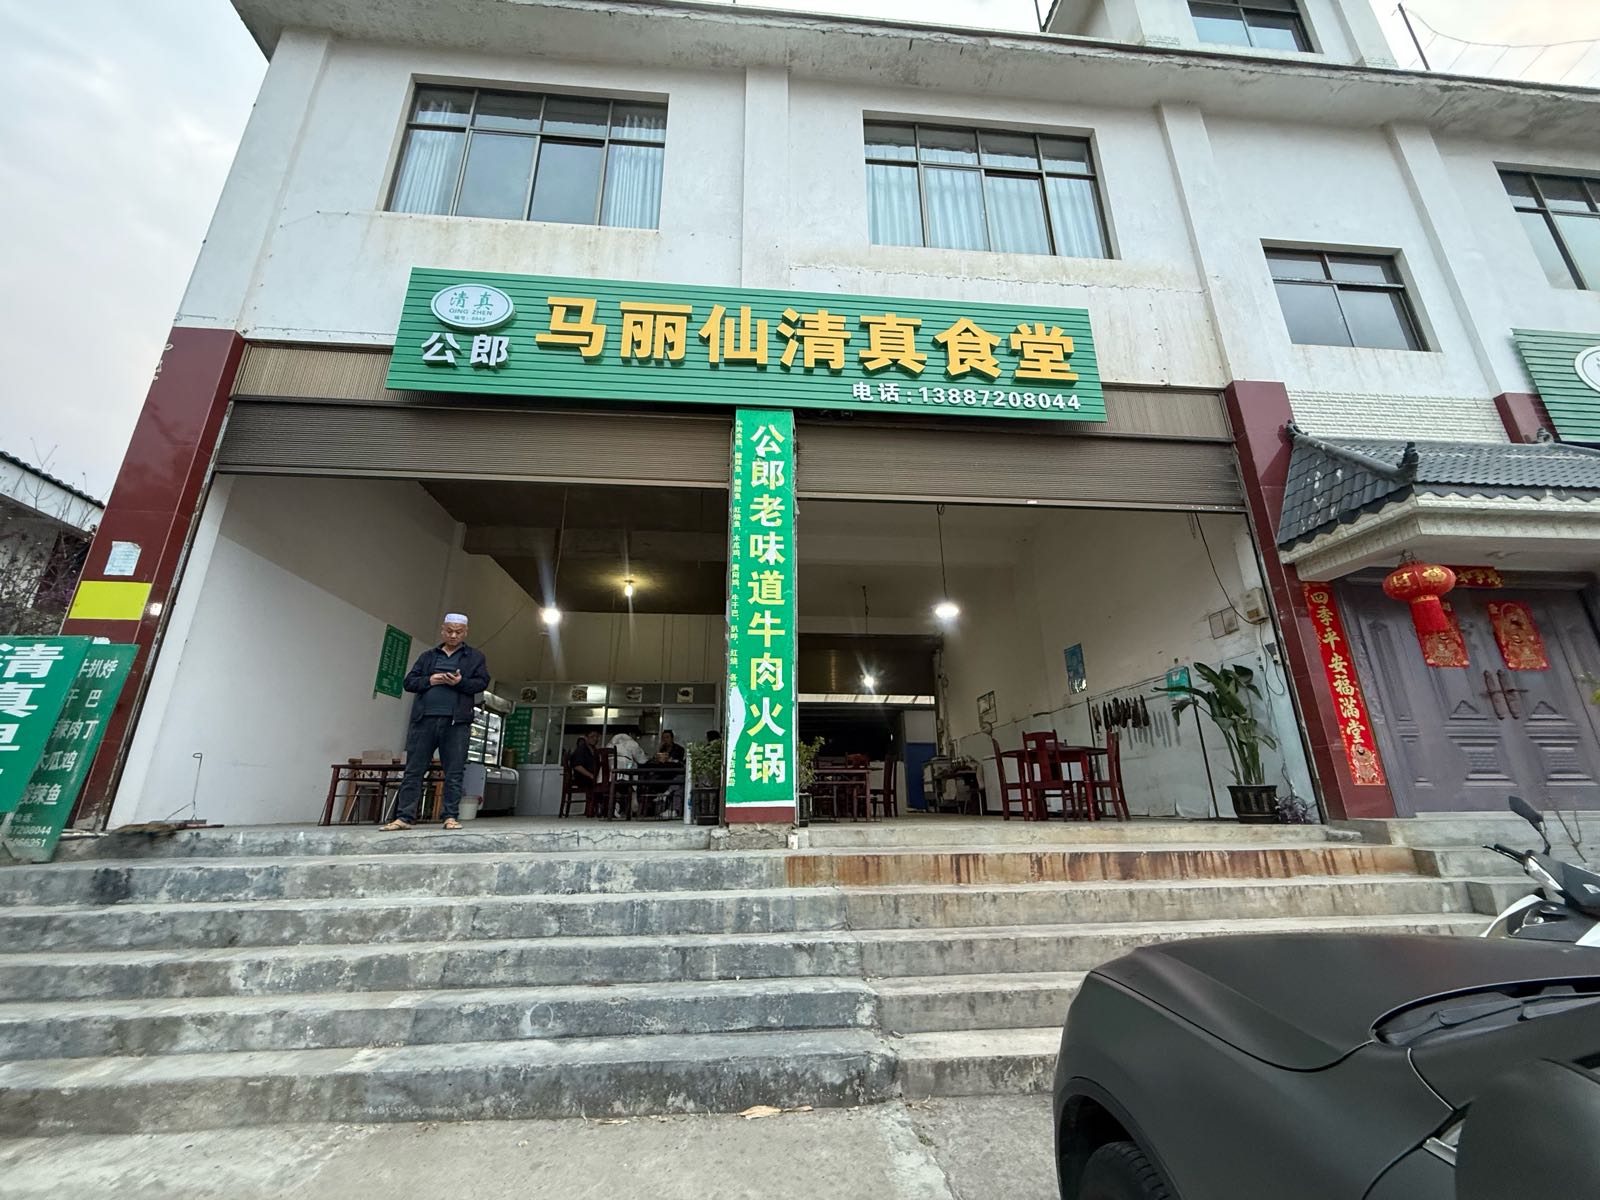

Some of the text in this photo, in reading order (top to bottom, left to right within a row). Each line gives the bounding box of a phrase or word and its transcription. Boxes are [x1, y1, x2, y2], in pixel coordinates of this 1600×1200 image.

[450, 290, 494, 310] 清真
[535, 296, 1078, 383] 马丽仙清真食堂
[421, 331, 510, 368] 公郎
[745, 424, 786, 785] 公郎老味道牛肉火锅
[1310, 592, 1366, 744] 四季平安福满堂
